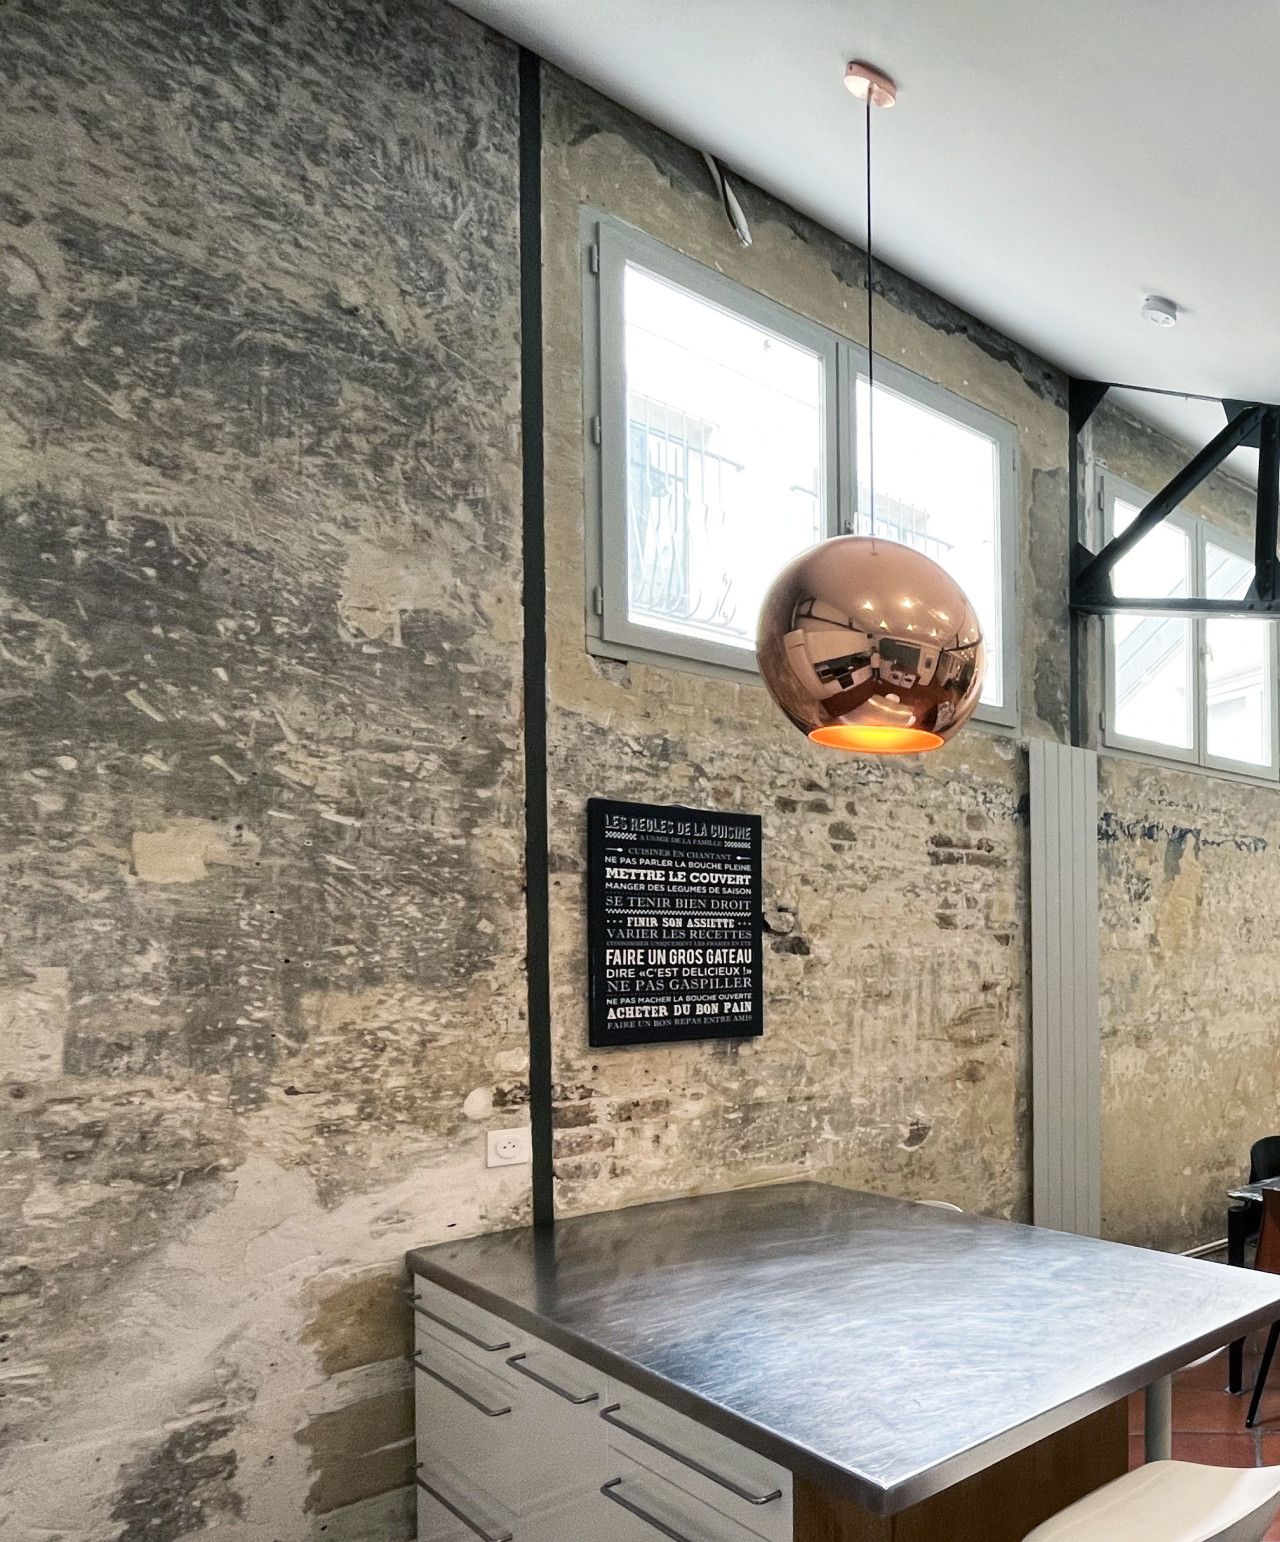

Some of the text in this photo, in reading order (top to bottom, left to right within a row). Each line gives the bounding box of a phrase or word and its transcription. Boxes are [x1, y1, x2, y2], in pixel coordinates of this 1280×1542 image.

[605, 814, 626, 830] LES
[678, 822, 690, 836] DE
[694, 823, 707, 837] LA
[711, 826, 751, 840] CUISINE
[628, 848, 731, 860] CUISINER EN CHANTANT
[639, 858, 672, 867] PARLER
[605, 867, 751, 885] METTRE LE COUVERT
[605, 882, 645, 891] MANGER
[668, 885, 706, 893] LEGUMES
[606, 896, 751, 910] SE TENIR BIEN DROIT
[627, 917, 734, 928] FINIR SON ASSIETTE
[607, 929, 751, 939] VARIER LES RECETTES
[606, 949, 751, 965] FAIRE UN GROS GATEAU
[606, 969, 635, 978] DIRE
[682, 968, 740, 976] DELICIEUX
[607, 978, 752, 992] NE PAS GASPILLER
[607, 1002, 752, 1019] ACHETER DU BON PAIN
[607, 1021, 635, 1030] FAIRE
[674, 1017, 700, 1026] REPAS
